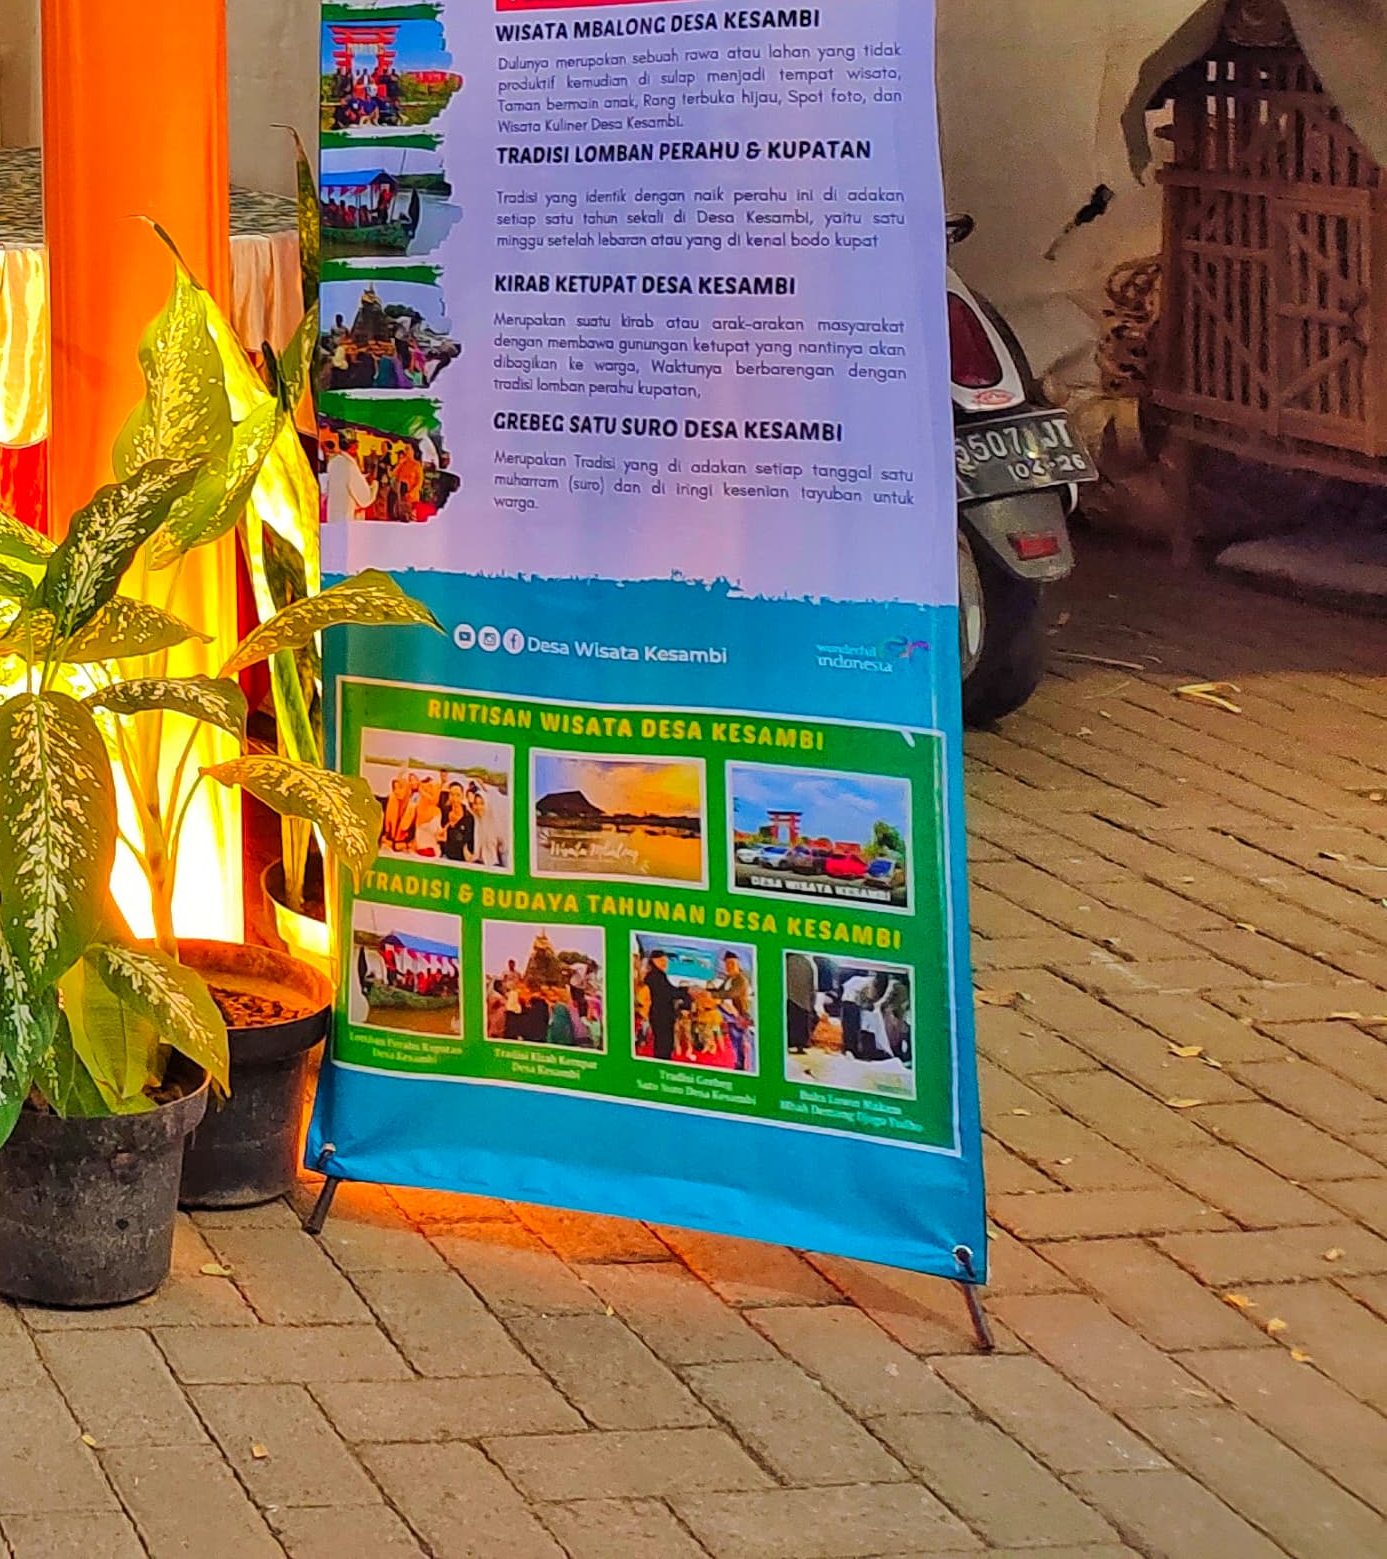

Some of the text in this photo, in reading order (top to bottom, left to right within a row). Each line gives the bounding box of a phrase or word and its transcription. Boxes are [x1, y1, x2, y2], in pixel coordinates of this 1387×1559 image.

[495, 8, 821, 42] WISATA MBALONG DESA KESAMBI
[498, 41, 903, 73] Dulunya merupakan sebuah rawa atau lahan yang tidak
[496, 139, 872, 164] TRADISI LOMBAN PERAHU & KUPATAN
[494, 274, 796, 295] KIRAB KETUPAT DESA KESAMBI
[493, 312, 905, 336] Merupakan suatu kirab atau arak-arakan masyarakat
[493, 412, 843, 442] GREBEG SATU SURO DESA KESAMBI
[493, 450, 914, 483] Merupakan Tradisi yang di adakan setiap tanggal satu
[527, 635, 729, 665] Desa Wisata Kesambi
[427, 697, 825, 751] RINTISAN WISATA DESA KESAMBI
[364, 869, 903, 950] TRADISI & BUDAYA TAHUNAN DESA KESAMBI
